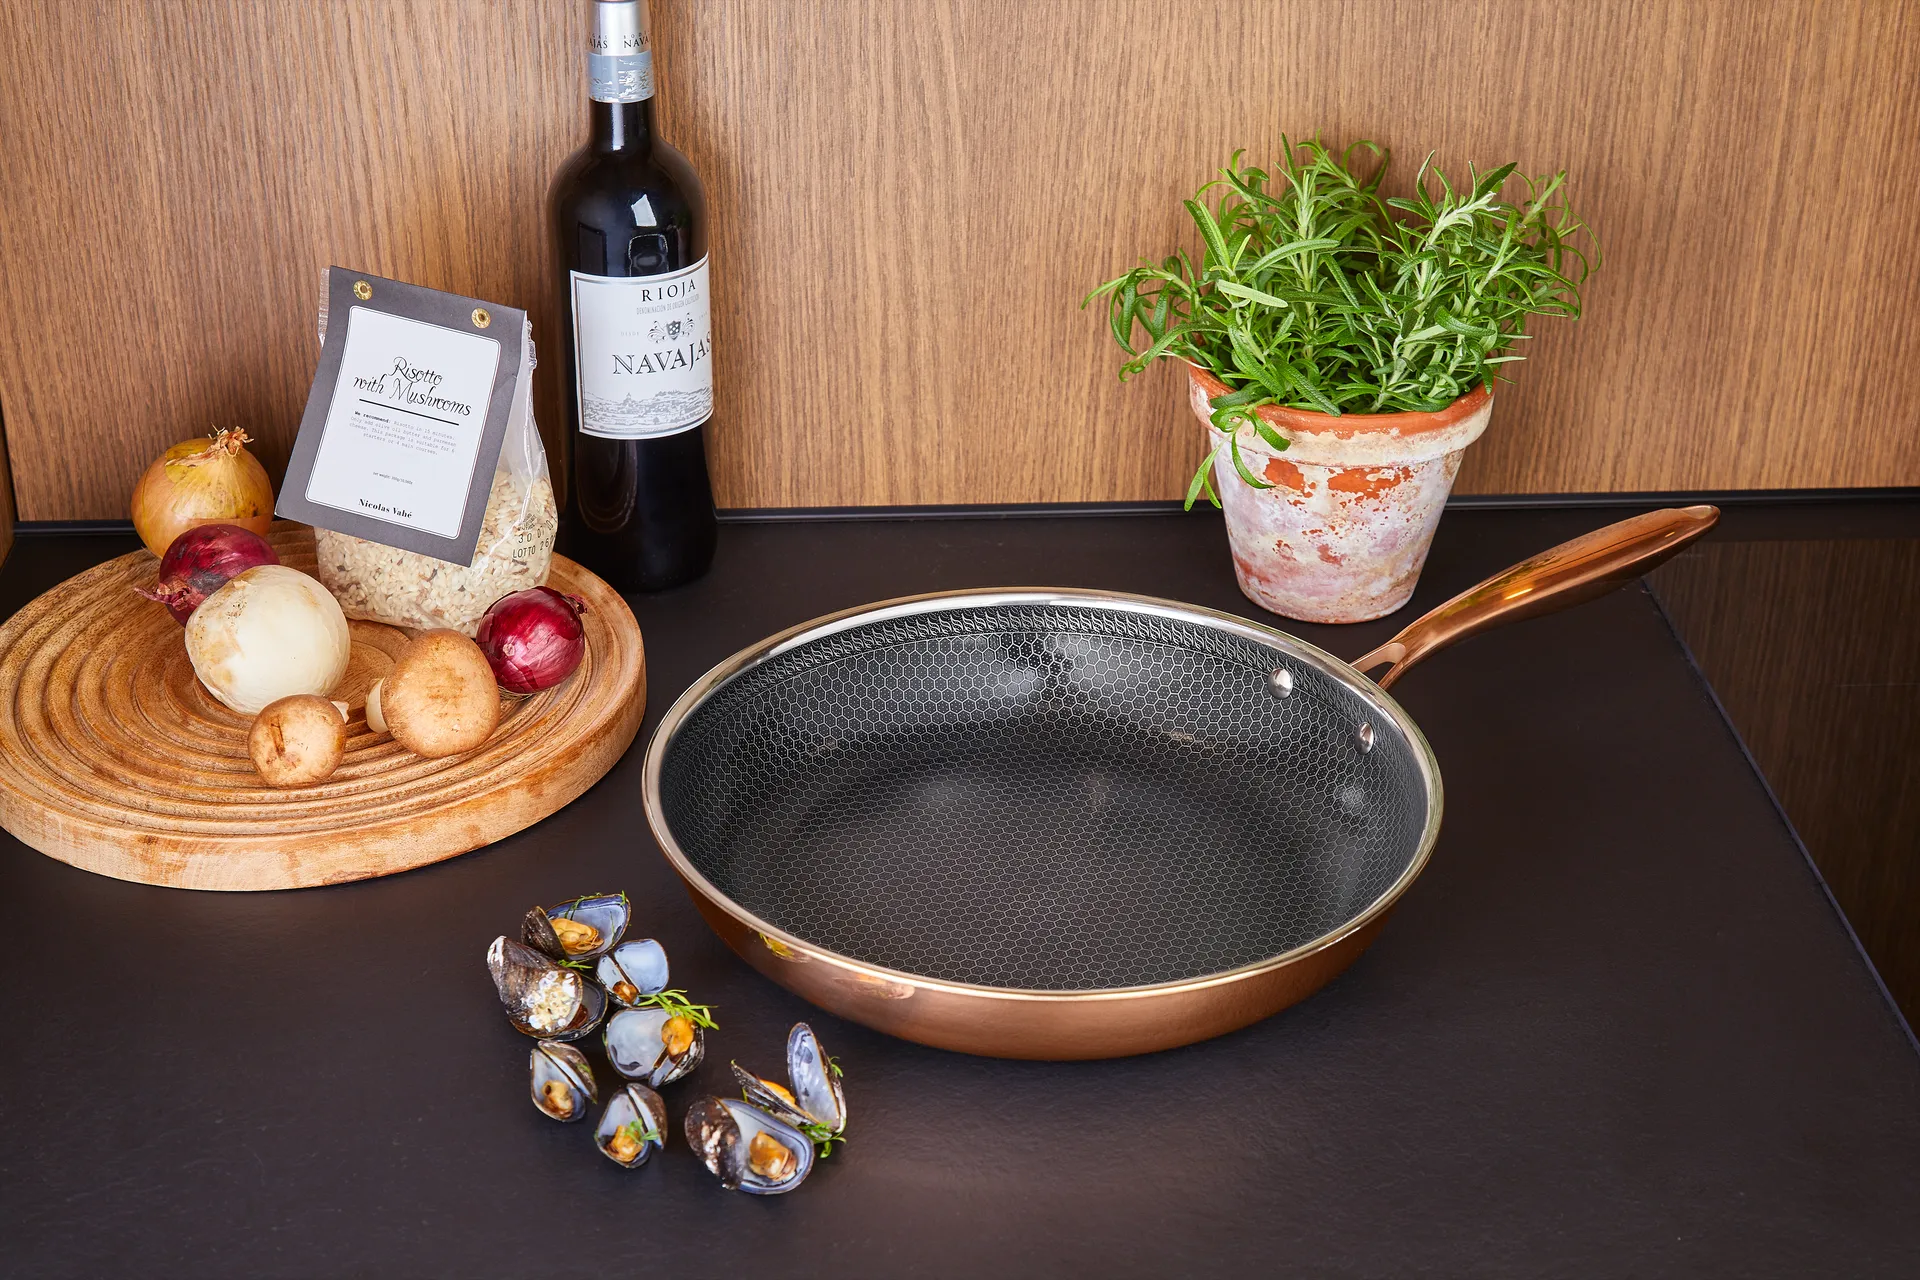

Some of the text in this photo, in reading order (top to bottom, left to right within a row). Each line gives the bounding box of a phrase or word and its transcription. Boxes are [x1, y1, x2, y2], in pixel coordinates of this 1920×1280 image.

[641, 279, 696, 302] RIOJA
[388, 356, 443, 386] Risotto
[353, 373, 472, 416] with Mushrooms
[358, 498, 413, 519] Nicolas Vahé
[512, 545, 536, 559] LOTTO
